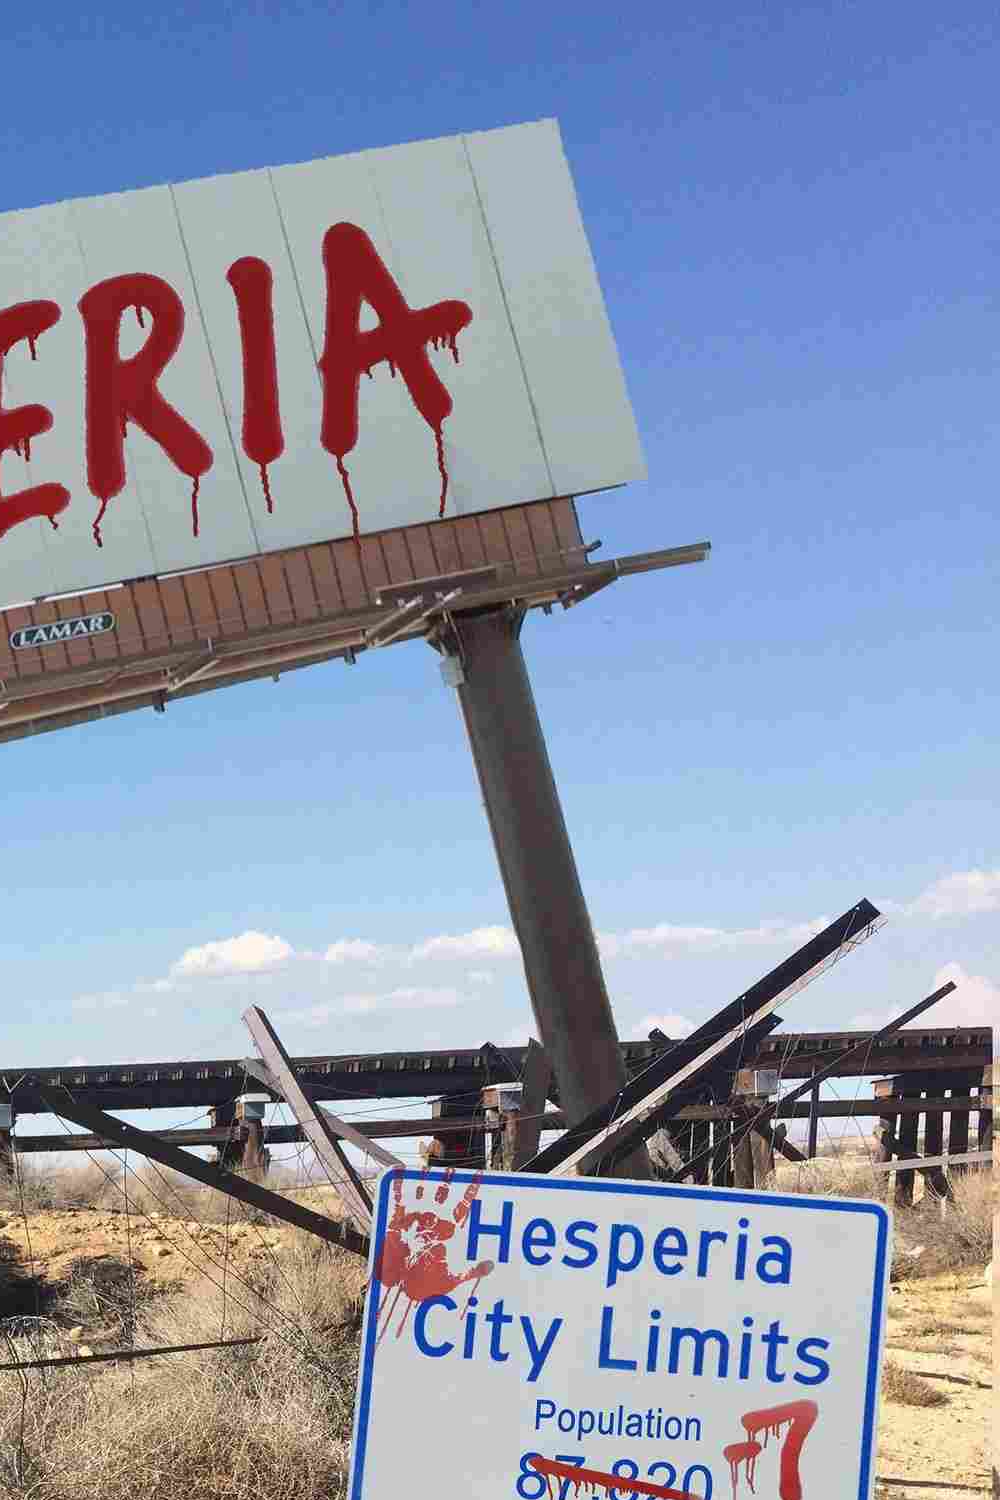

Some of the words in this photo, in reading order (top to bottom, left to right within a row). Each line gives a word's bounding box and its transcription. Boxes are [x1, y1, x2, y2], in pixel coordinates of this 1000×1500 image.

[19, 616, 105, 646] LAMAR
[465, 1199, 793, 1288] Hesperia
[413, 1294, 564, 1383] City
[597, 1306, 831, 1386] Limits
[534, 1399, 703, 1442] Population
